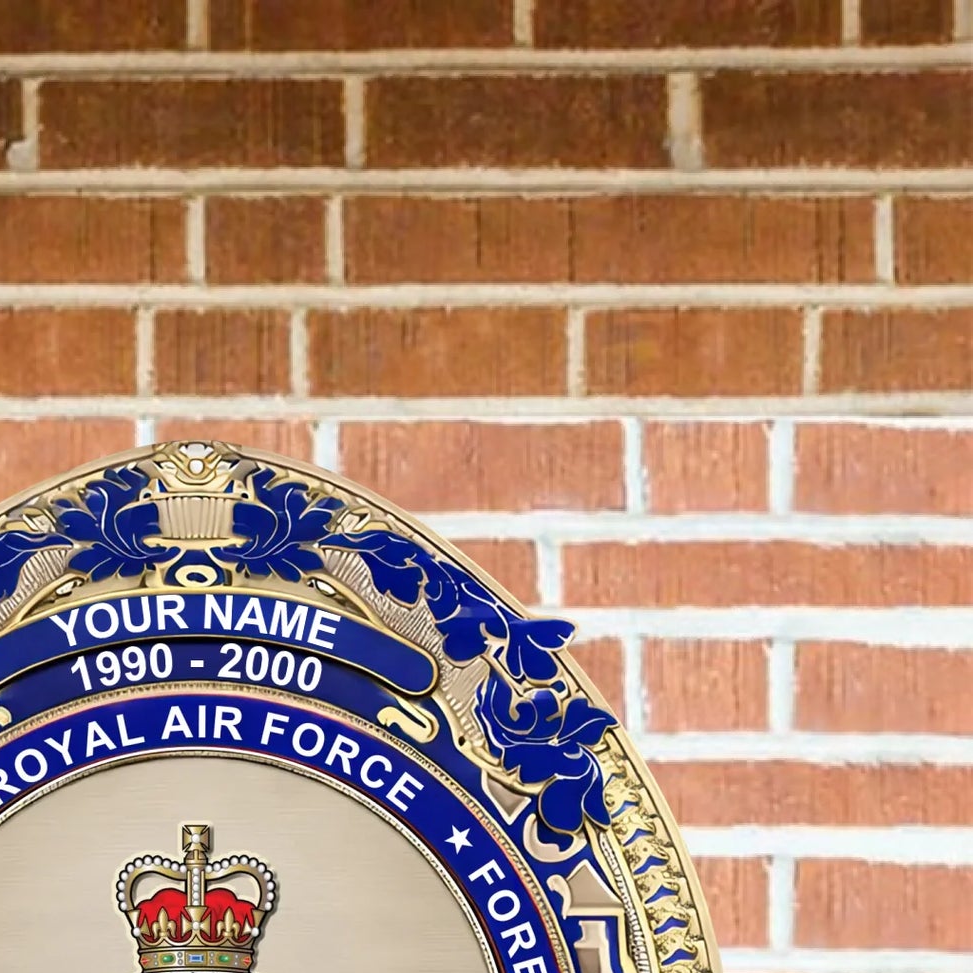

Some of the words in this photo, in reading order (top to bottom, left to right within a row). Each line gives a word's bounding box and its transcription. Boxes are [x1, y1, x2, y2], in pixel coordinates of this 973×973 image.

[48, 594, 189, 648] YOUR
[203, 596, 343, 650] NAME
[69, 643, 174, 692] 1990
[189, 659, 205, 668] -
[217, 643, 323, 692] 2000
[161, 704, 244, 740] AIR
[259, 711, 425, 812] FORCE
